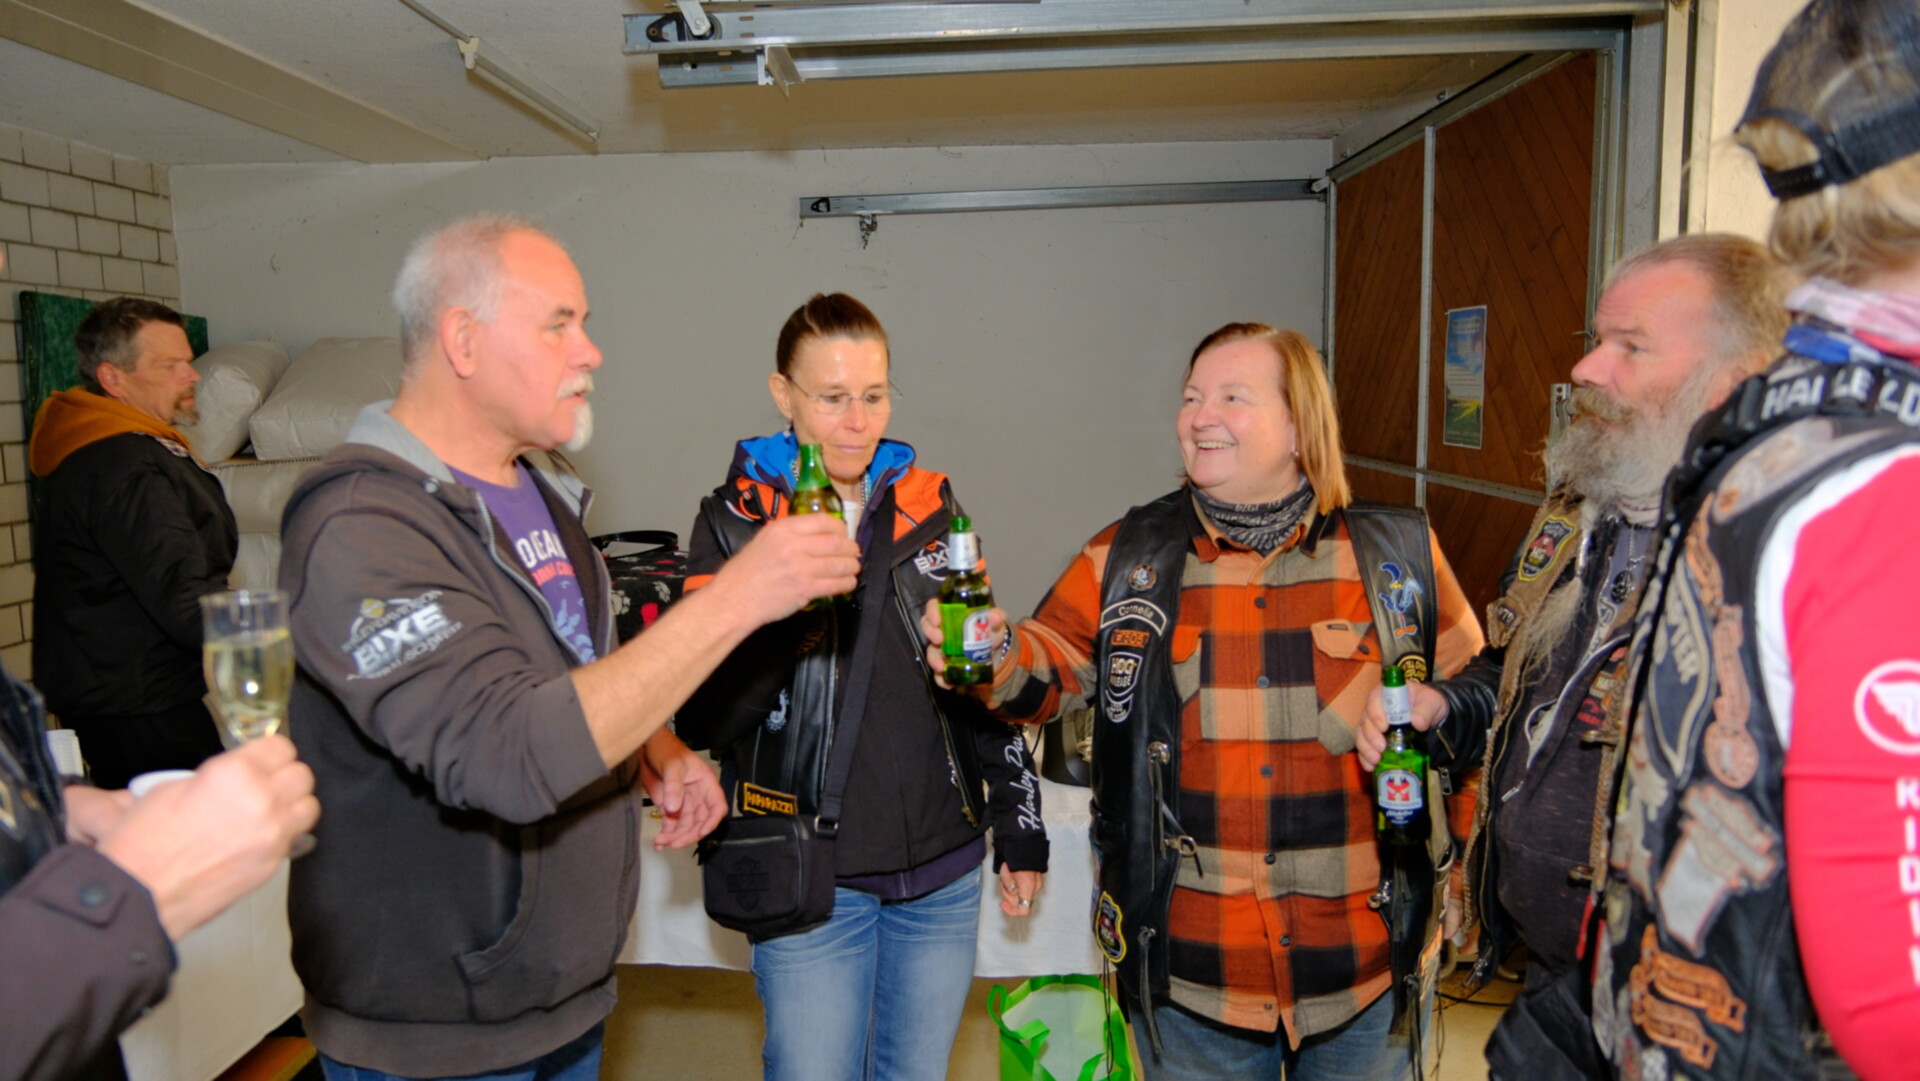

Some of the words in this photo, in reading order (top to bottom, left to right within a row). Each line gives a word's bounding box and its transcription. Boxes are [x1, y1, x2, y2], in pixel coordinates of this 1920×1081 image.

[353, 602, 450, 675] BIXE
[1118, 606, 1154, 619] Cornelia
[1009, 768, 1041, 831] Harley
